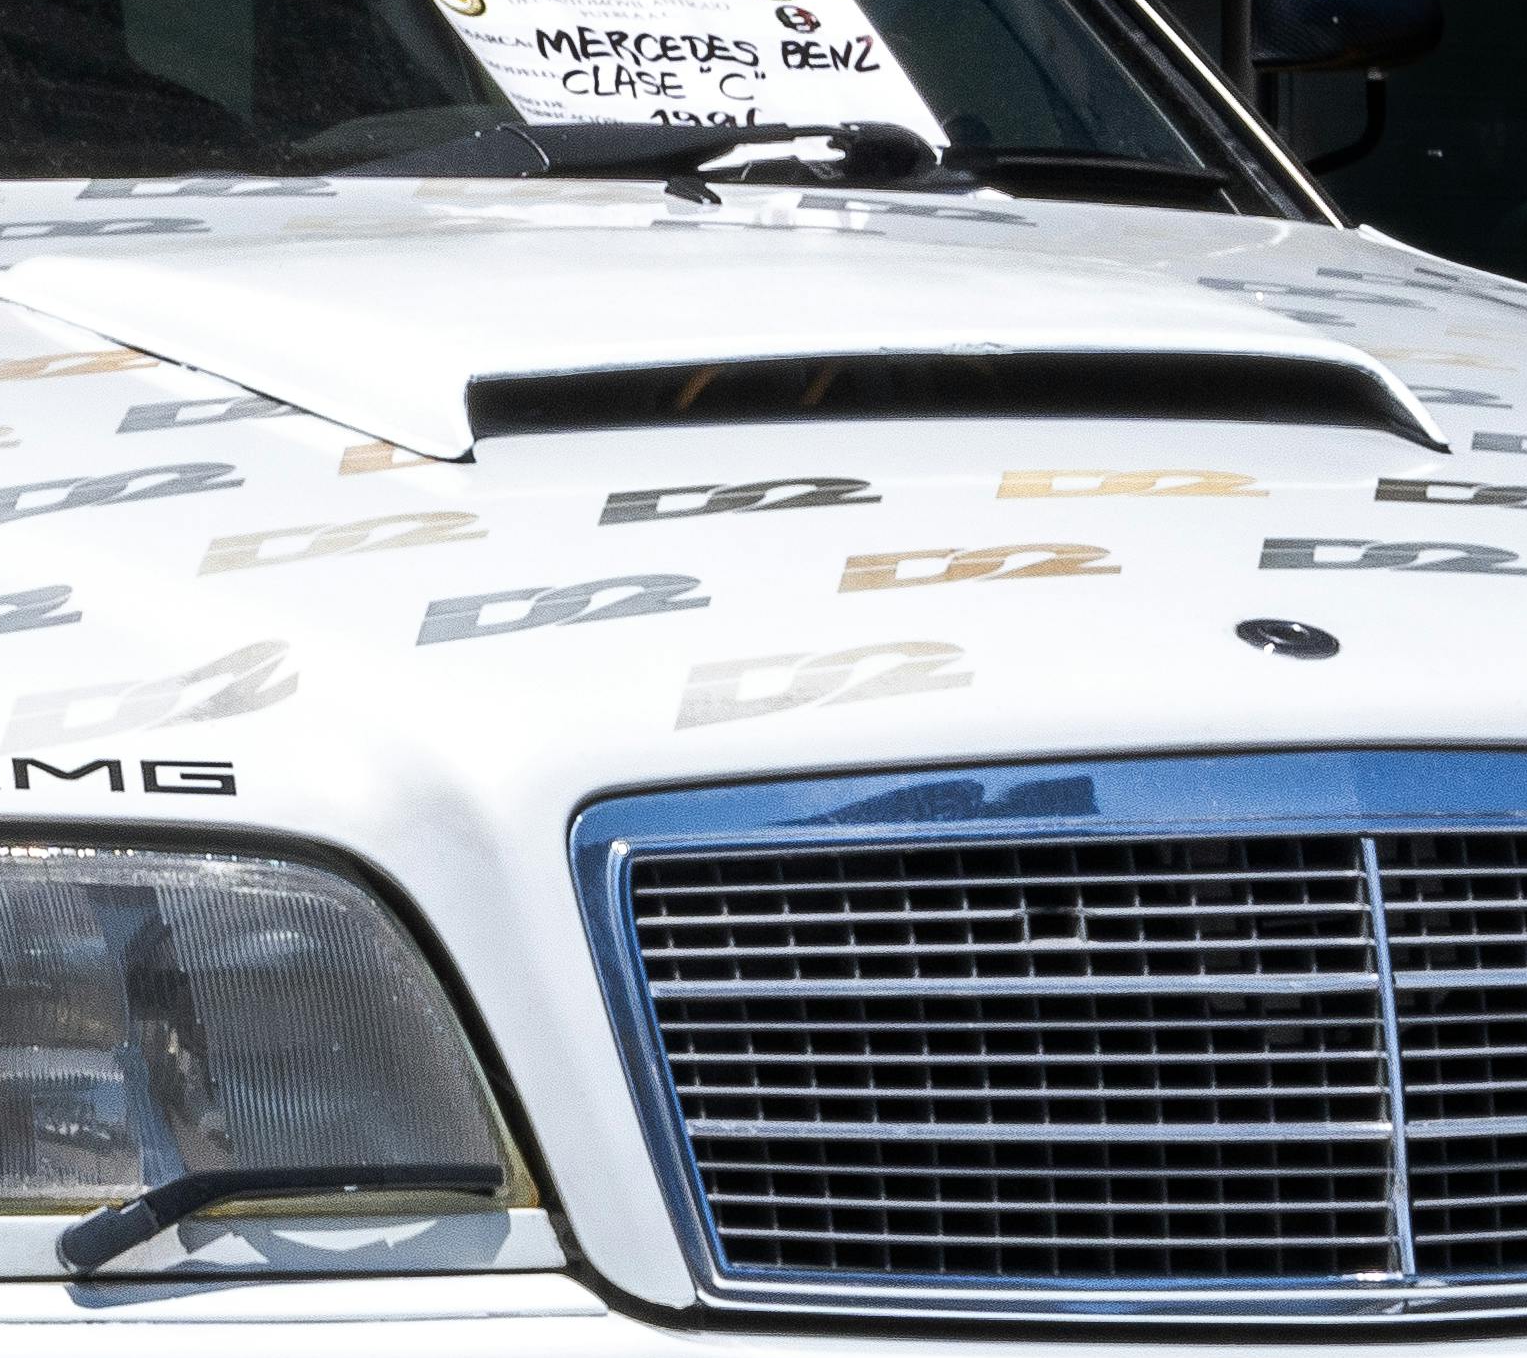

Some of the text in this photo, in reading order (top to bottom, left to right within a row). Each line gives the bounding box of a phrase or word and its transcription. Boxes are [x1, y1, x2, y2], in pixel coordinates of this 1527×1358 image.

[535, 26, 759, 66] MERCEDES
[562, 65, 686, 99] CLASE
[76, 178, 339, 201] D2
[598, 475, 882, 527] D2
[996, 468, 1271, 500] D2
[196, 511, 490, 578] D2
[837, 541, 1123, 594] D2
[415, 572, 711, 646] D2
[0, 638, 300, 755] D2
[674, 639, 976, 732] D2
